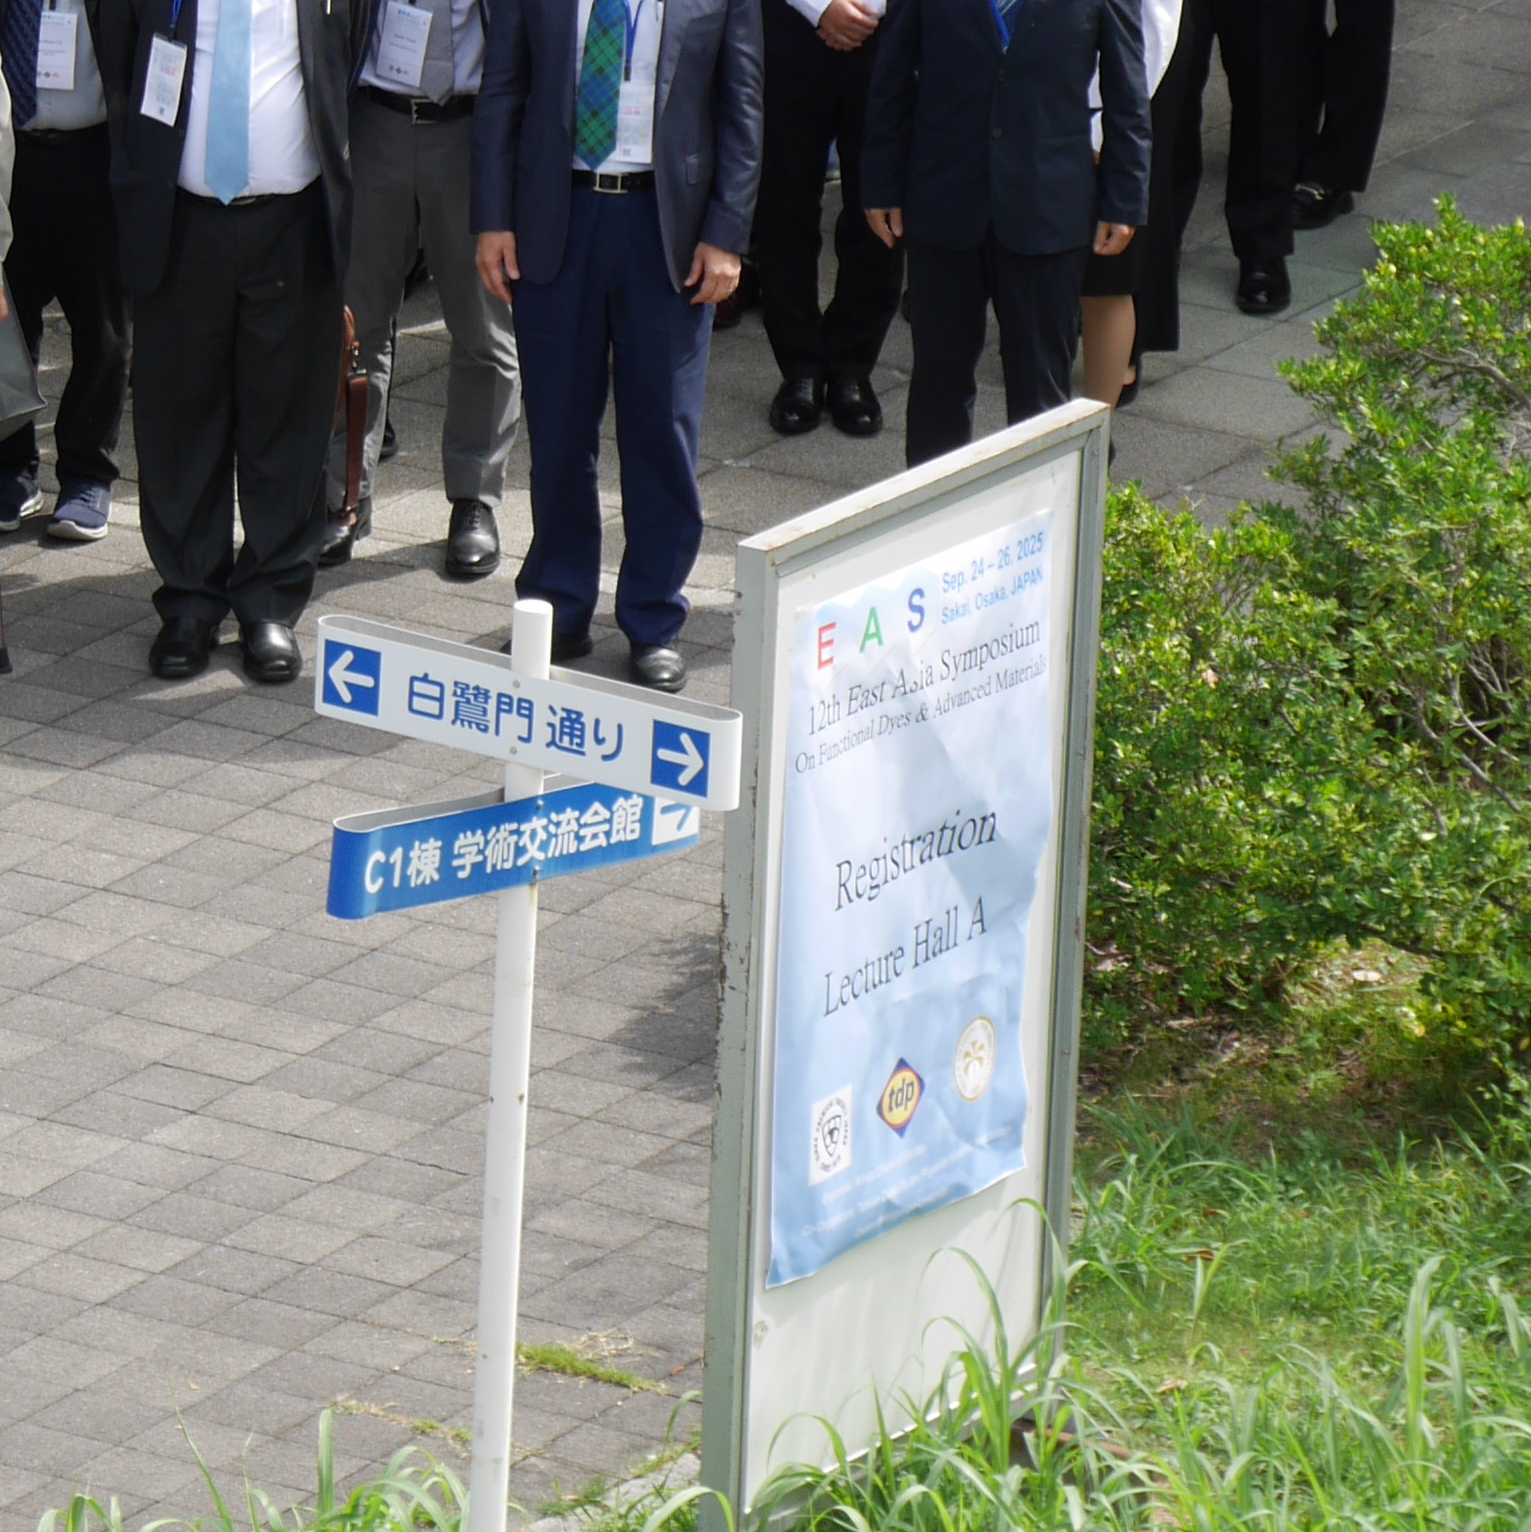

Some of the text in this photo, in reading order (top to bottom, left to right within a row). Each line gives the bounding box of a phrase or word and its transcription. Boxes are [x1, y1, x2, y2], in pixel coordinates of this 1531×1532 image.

[942, 571, 968, 593] Sep.
[971, 556, 985, 582] 24
[1016, 531, 1043, 562] 2025
[1010, 565, 1043, 595] JAPAN
[795, 653, 1047, 774] On Functional Dyes & Advanced Materials
[809, 693, 841, 736] 12th
[847, 679, 887, 717] East
[940, 621, 1040, 682] Symposium
[364, 794, 644, 894] C1棟 学術交流会館
[835, 809, 997, 912] Registration
[823, 894, 988, 1018] Lecture Hall A
[888, 1077, 915, 1113] tdp
